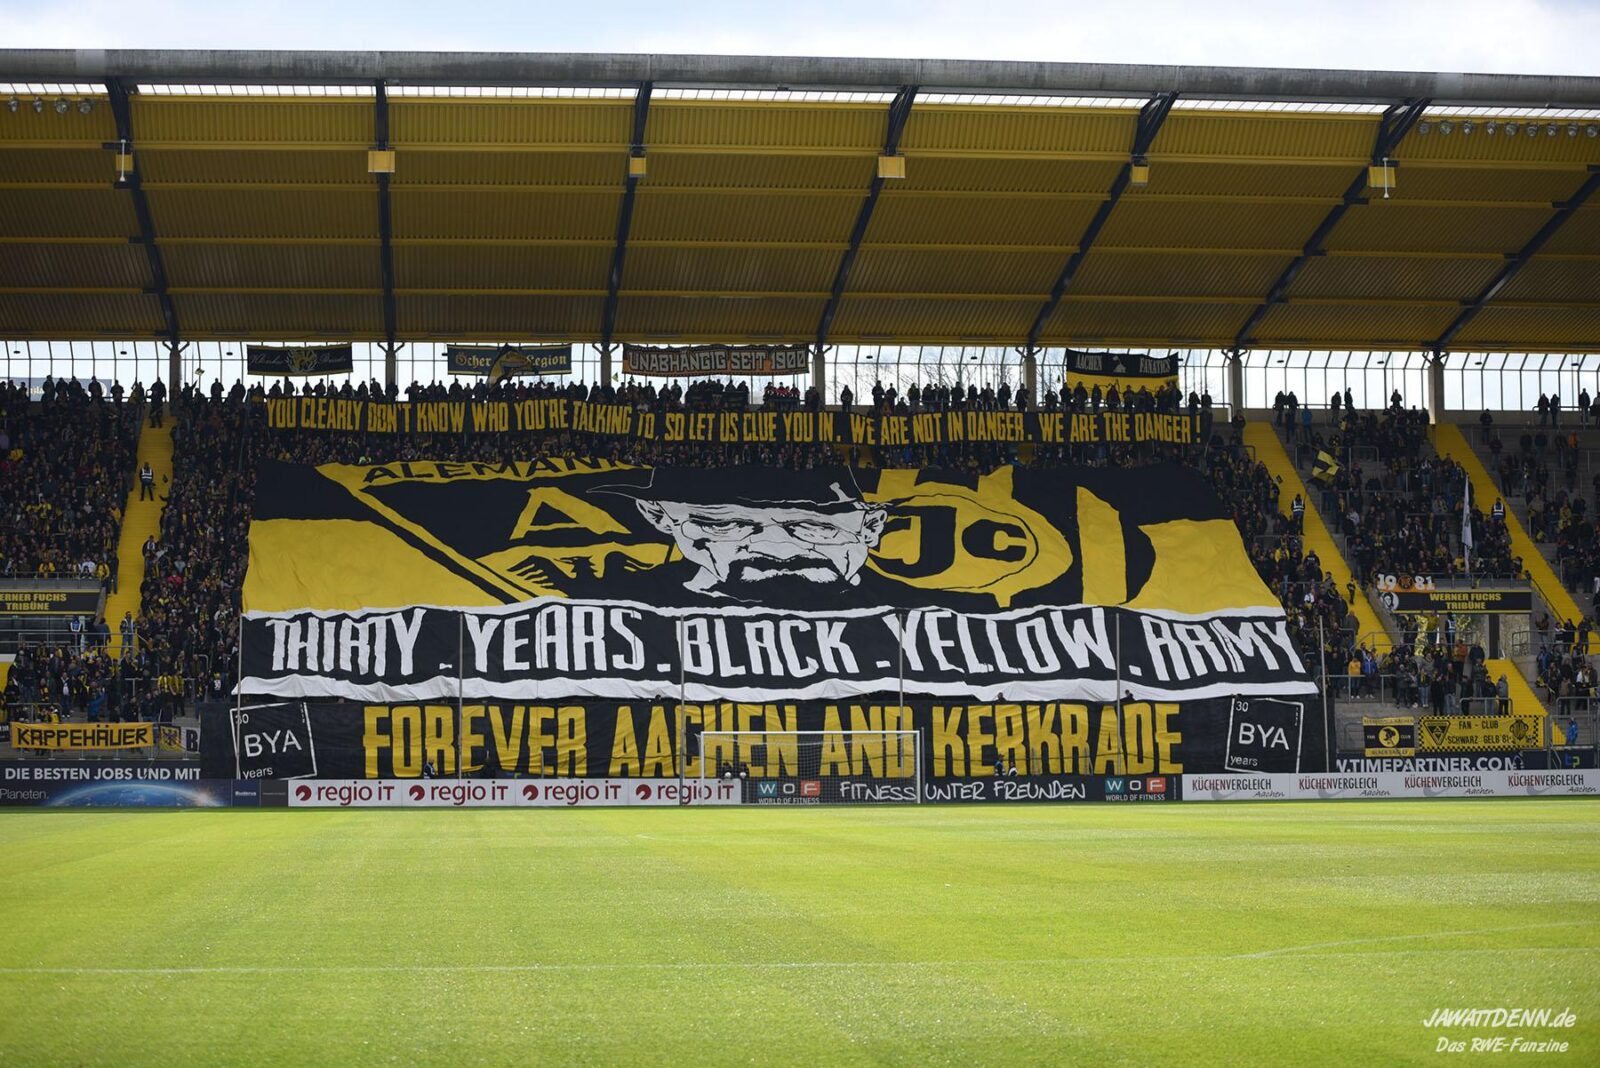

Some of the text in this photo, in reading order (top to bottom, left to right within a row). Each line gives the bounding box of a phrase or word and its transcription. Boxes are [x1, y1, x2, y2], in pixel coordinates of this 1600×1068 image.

[629, 350, 806, 372] UNABHÄNGIG SEIT 1900
[267, 398, 297, 428] YOU
[301, 398, 363, 431] CLEARLY
[367, 402, 412, 433] DON'T
[417, 402, 465, 433] KNOW
[471, 401, 509, 432] WHO
[514, 399, 569, 431] YOU'RE
[572, 400, 633, 434] TALKING
[664, 413, 685, 441] SO
[689, 413, 715, 441] LET
[719, 412, 738, 442] US
[743, 412, 777, 442] CLUE
[783, 411, 813, 442] YOU
[850, 413, 876, 445] WE
[880, 415, 909, 446] ARE
[913, 413, 942, 444] NOT
[947, 411, 964, 442] IN
[1039, 412, 1064, 443] WE
[1070, 413, 1099, 443] ARE
[1103, 412, 1131, 443] THE
[33, 593, 67, 602] FUCHS
[1430, 593, 1501, 601] WERNER FUCHS
[6, 601, 50, 610] TRIBÜNE
[1446, 601, 1486, 610] TRIBÜNE
[464, 605, 644, 673] YEARS
[676, 617, 859, 677] BLACK
[882, 607, 1117, 675] YELLOW
[1140, 614, 1307, 681] ARMY
[1235, 700, 1249, 713] 30
[1458, 720, 1472, 730] FAN
[1481, 720, 1499, 730] CLUB
[16, 725, 148, 747] KAPPEHÄUER
[244, 729, 303, 758] BYA
[363, 703, 1184, 779] FOREVER AACHEN AND KERKRADE
[1238, 722, 1290, 751] BYA
[1230, 756, 1259, 768] years
[5, 767, 201, 781] DIE BESTEN JOBS UND MIT
[243, 766, 274, 780] years
[1508, 773, 1584, 787] KÜCHENVERGLEICH
[1192, 777, 1271, 791] KÜCHENVERGLEICH
[1299, 775, 1377, 790] KÜCHENVERGLEICH
[1404, 774, 1482, 788] KÜCHENVERGLEICH
[317, 781, 372, 805] regio
[431, 781, 486, 805] regio
[544, 780, 599, 805] regio
[657, 780, 712, 805] regio
[840, 780, 1085, 800] FITNESS UNTER FREUNDEN
